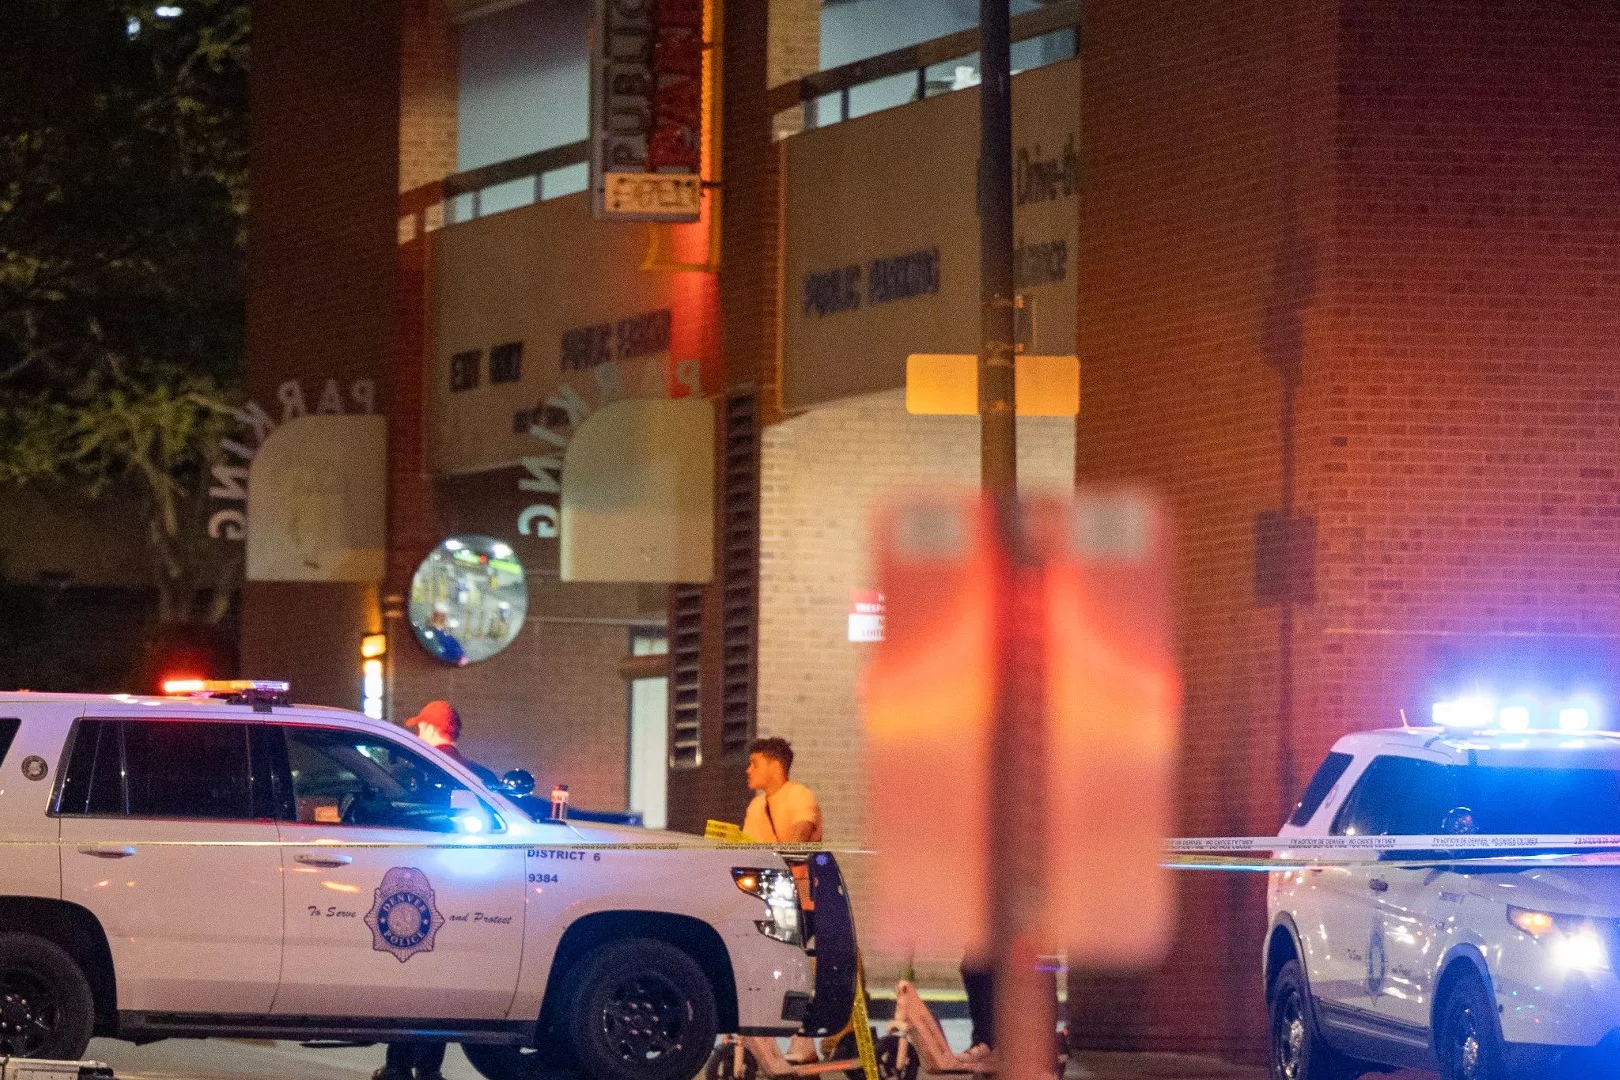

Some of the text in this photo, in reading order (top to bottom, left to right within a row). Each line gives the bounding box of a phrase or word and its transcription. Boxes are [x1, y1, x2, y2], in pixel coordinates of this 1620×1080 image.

[527, 849, 601, 862] DISTRICT 6
[528, 873, 558, 884] 9384
[382, 894, 427, 912] DENVER
[307, 905, 358, 918] To Serve
[448, 911, 513, 925] and Protect
[383, 930, 426, 947] POLICE
